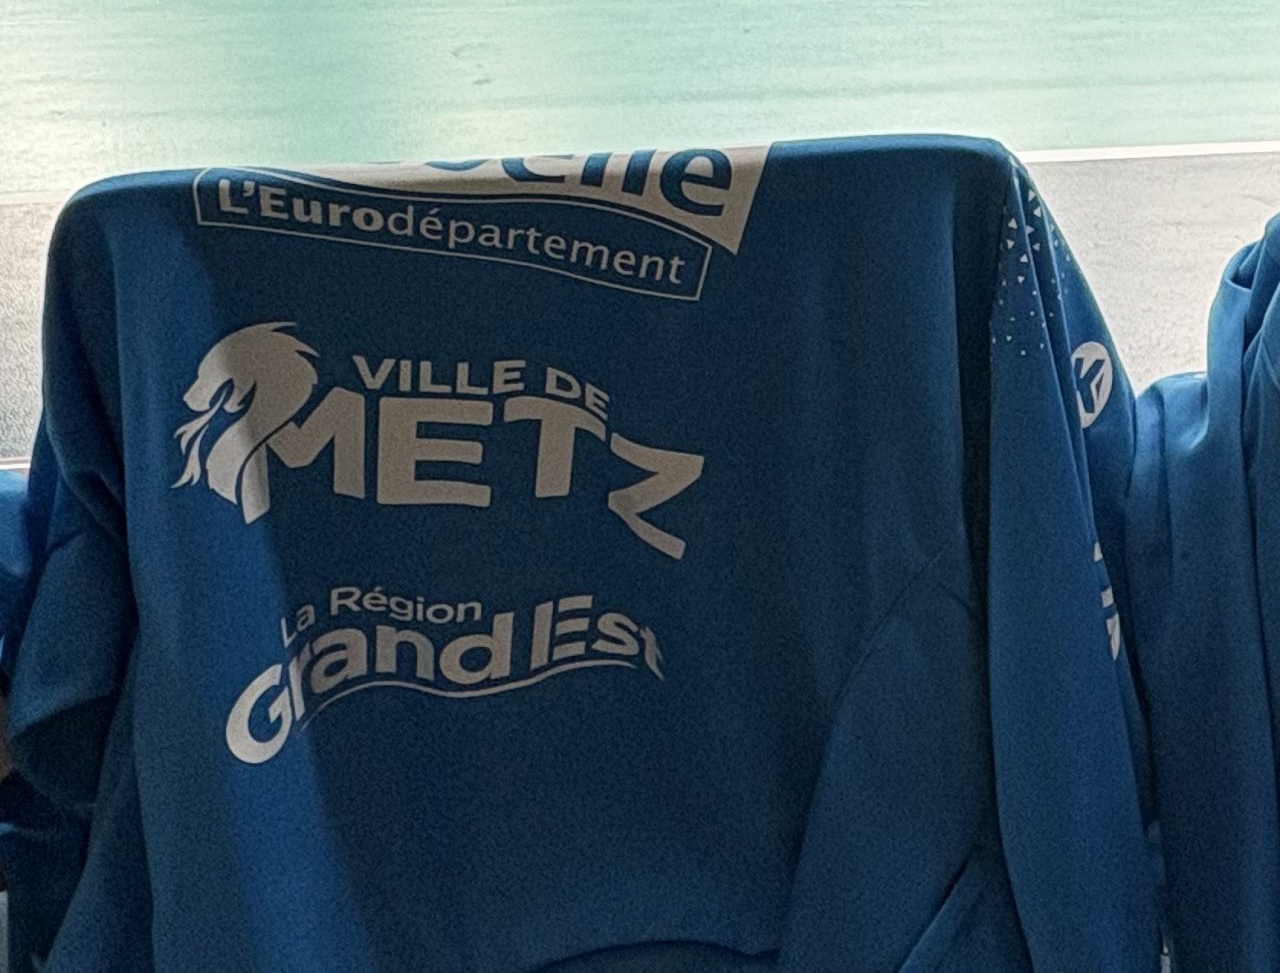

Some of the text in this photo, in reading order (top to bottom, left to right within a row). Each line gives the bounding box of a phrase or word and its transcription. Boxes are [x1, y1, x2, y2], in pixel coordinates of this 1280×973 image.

[216, 177, 687, 286] L'Eurodépartement
[352, 354, 610, 421] VILLE DE
[242, 386, 705, 560] METZ
[280, 586, 482, 648] La Région
